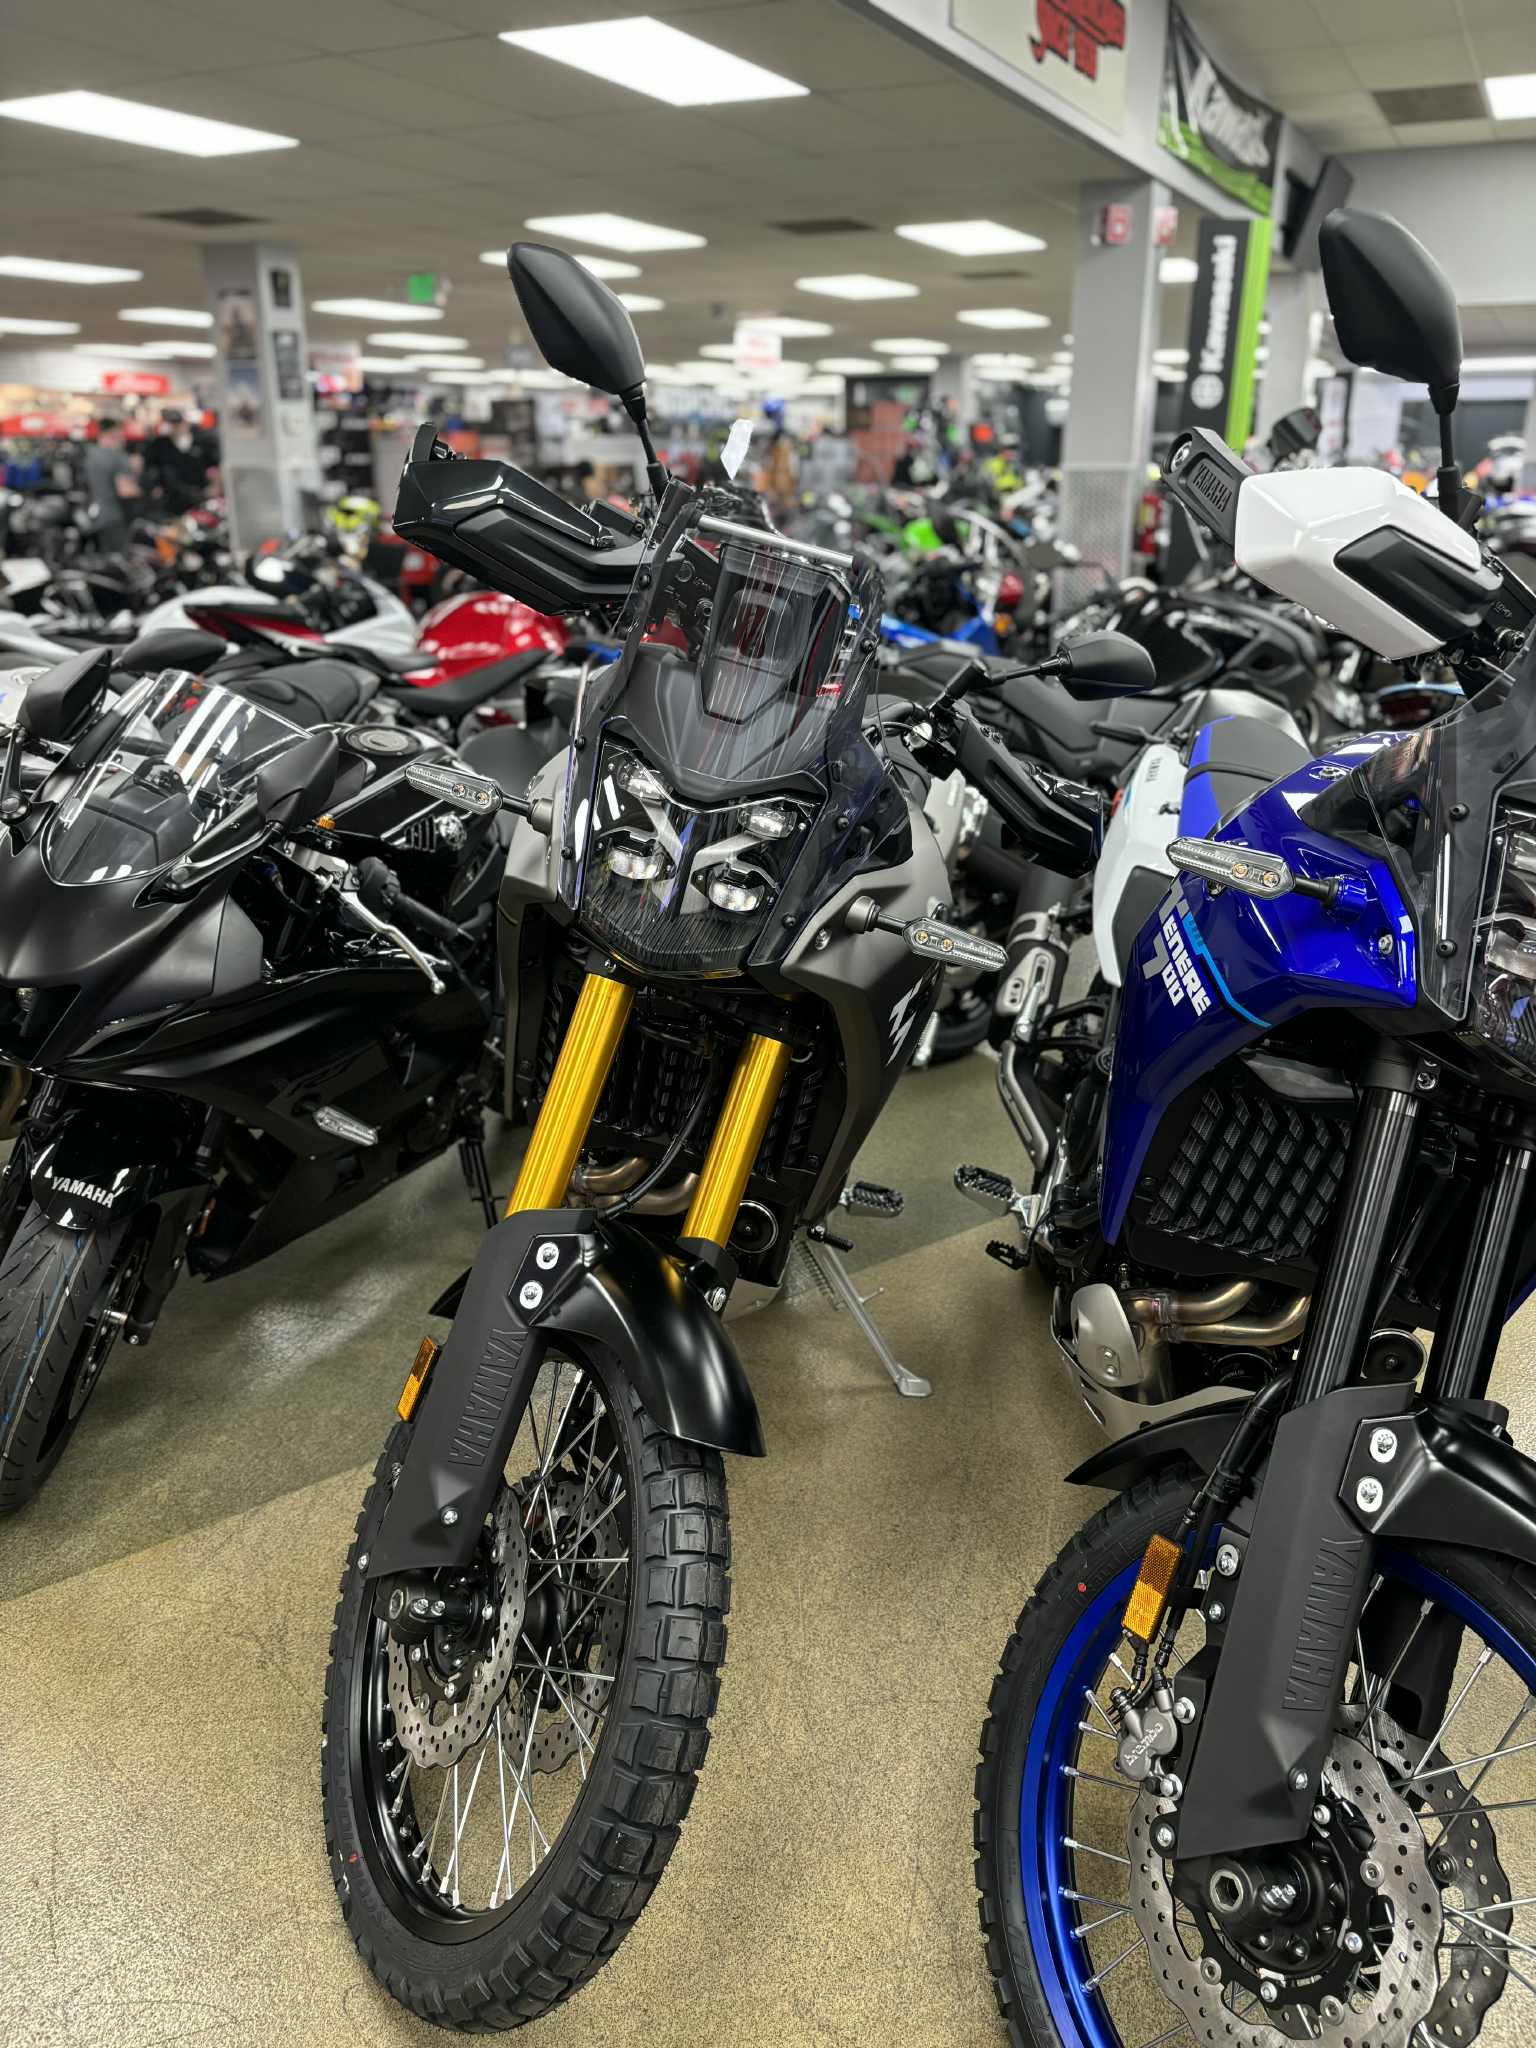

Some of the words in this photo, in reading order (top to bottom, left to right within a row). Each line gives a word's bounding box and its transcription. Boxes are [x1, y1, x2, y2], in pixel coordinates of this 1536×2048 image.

[1192, 463, 1233, 513] YAMAHA
[1142, 931, 1185, 1007] 700
[51, 1176, 115, 1209] YAMAHA
[448, 1328, 529, 1467] YAMAHA
[1281, 1537, 1364, 1712] YAMAHA
[1124, 1722, 1164, 1767] brembo
